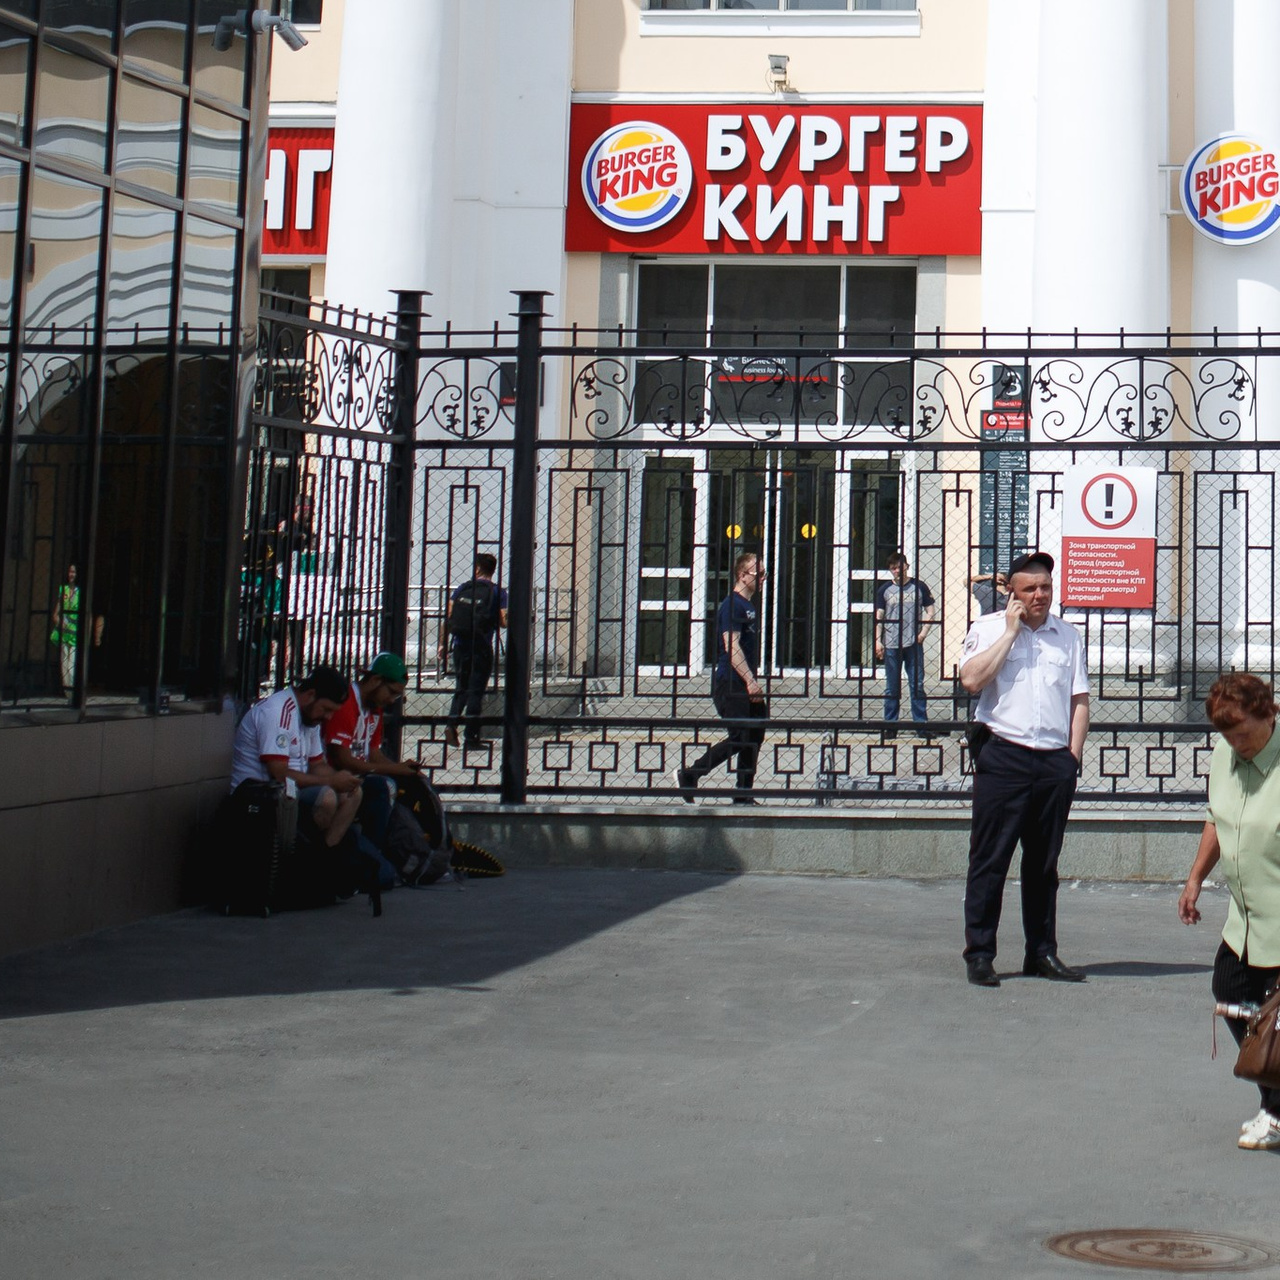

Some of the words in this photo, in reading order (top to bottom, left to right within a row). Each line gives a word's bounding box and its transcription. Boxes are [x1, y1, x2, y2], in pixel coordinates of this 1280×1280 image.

[705, 115, 970, 173] БУРГЕР
[597, 145, 676, 179] BURGER
[1195, 153, 1276, 192] BURGER
[598, 162, 678, 205] KING
[1198, 171, 1279, 219] KING
[703, 184, 900, 243] КИНГ
[1068, 541, 1086, 549] Зона
[1087, 541, 1136, 551] транспортной
[1068, 559, 1095, 567] Проход
[1095, 559, 1125, 568] (проезд)
[1091, 568, 1140, 577] транспортной
[1067, 576, 1115, 584] безопасности
[1130, 577, 1146, 585] КПП
[1067, 585, 1100, 593] (участков
[1101, 586, 1137, 594] досмотра)
[1067, 594, 1105, 602] запрещен!
